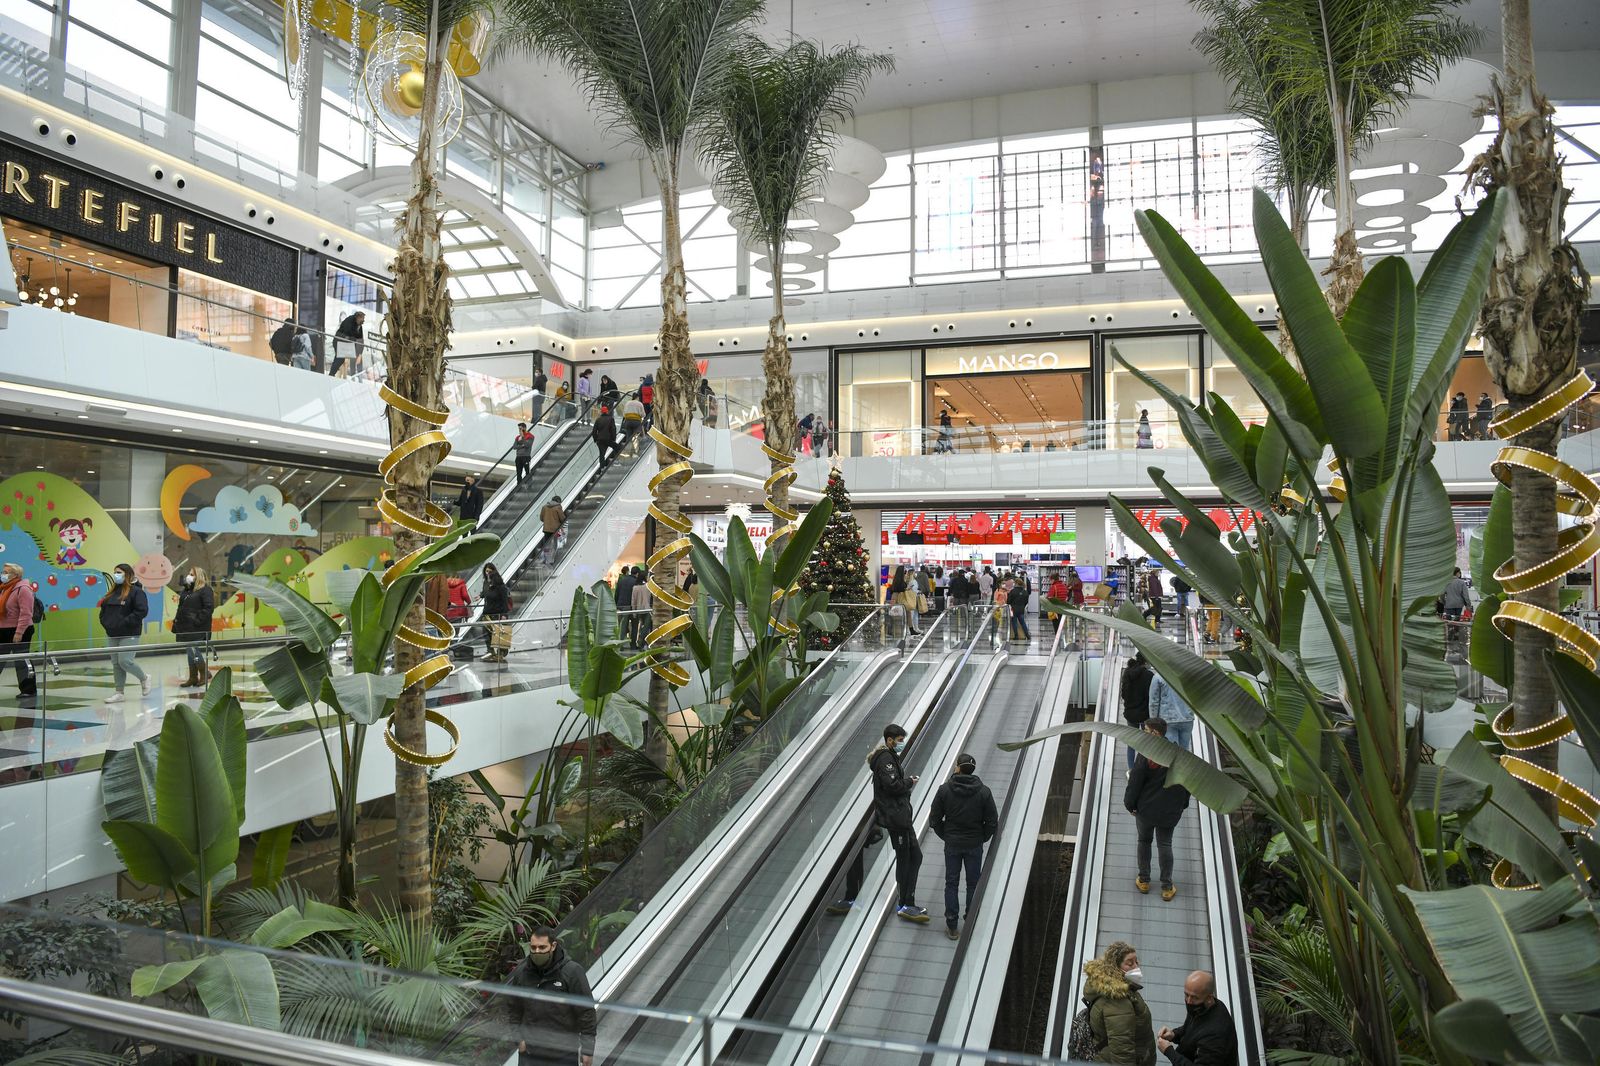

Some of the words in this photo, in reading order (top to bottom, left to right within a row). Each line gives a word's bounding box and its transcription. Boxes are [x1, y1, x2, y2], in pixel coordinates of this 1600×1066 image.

[4, 160, 223, 264] RTEFIEL
[958, 352, 1059, 373] MANGO
[893, 512, 971, 535] Media
[990, 512, 1061, 535] Markt
